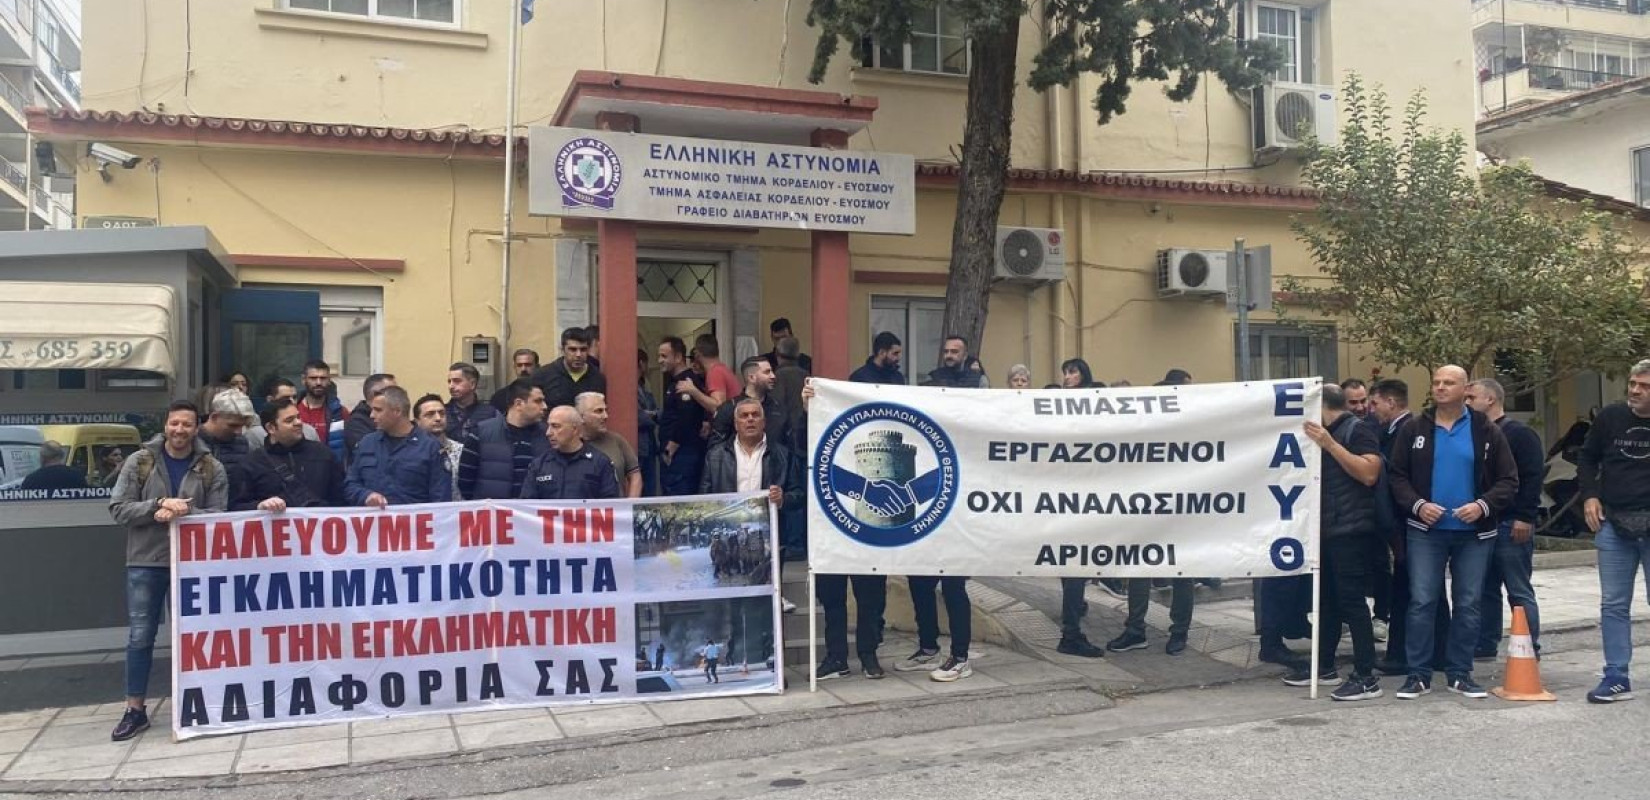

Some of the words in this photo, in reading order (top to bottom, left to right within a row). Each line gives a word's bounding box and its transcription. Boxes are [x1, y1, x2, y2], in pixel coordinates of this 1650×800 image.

[557, 139, 584, 189] ΕΛΛΗΝΙΚΗ
[587, 139, 621, 192] ΑΣΤΥΝΟΜΙΑ
[650, 143, 756, 167] ΕΛΛΗΝΙΚΗ
[766, 152, 881, 175] ΑΣΤΥΝΟΜΙΑ
[643, 168, 720, 183] ΑΣΤΥΝΟΜΙΚΟ
[725, 174, 767, 186] ΤΜΗΜΑ
[772, 177, 834, 190] ΚΟΡΔΕΛΙΟΥ
[844, 182, 895, 194] ΕΥΟΣΜΟΥ
[649, 186, 692, 198] ΤΜΗΜΑ
[697, 189, 763, 203] ΑΣΦΑΛΕΙΑΣ
[768, 194, 830, 207] ΚΟΡΔΕΛΙΟΥ
[839, 198, 890, 210] ΕΥΟΣΜΟΥ
[677, 205, 728, 217] ΓΡΑΦΕΙΟ
[814, 213, 866, 225] ΕΥΟΣΜΟΥ
[36, 340, 79, 359] 685
[90, 341, 133, 360] 359
[48, 413, 126, 423] ΑΣΤΥΝΟΜΙΑ
[846, 408, 918, 424] ΥΠΑΛΛΗΛΩΝ
[1033, 395, 1181, 415] ΕΙΜΑΣΤΕ
[917, 421, 949, 453] ΝΟΜΟΥ
[819, 421, 850, 500] ΑΣΤΥΝΟΜΙΚΩΝ
[988, 441, 1225, 463] ΕΡΓΑΖΟΜΕΝΟΙ
[910, 457, 953, 534] ΘΕΣΣΑΛΟΝΙΚΗΣ
[967, 491, 1023, 513] ΟΧΙ
[1034, 492, 1246, 514] ΑΝΑΛΩΣΙΜΟΙ
[828, 501, 861, 533] ΕΝΩΣΗ
[179, 513, 435, 561] ΠΑΛΕΥΟΥΜΕ
[459, 508, 514, 547] ΜΕ
[537, 507, 614, 543] ΤΗΝ
[1034, 544, 1176, 566] ΑΡΙΘΜΟΙ
[180, 557, 617, 616] ΕΓΚΛΗΜΑΤΙΚΟΤΗΤΑ
[181, 628, 251, 672] ΚΑΙ
[261, 623, 342, 664] ΤΗΝ
[352, 607, 616, 658] ΕΓΚΛΗΜΑΤΙΚΗ
[181, 663, 504, 727] ΑΔΙΑΦΟΡΙΑ
[535, 658, 619, 696] ΣΑΣ
